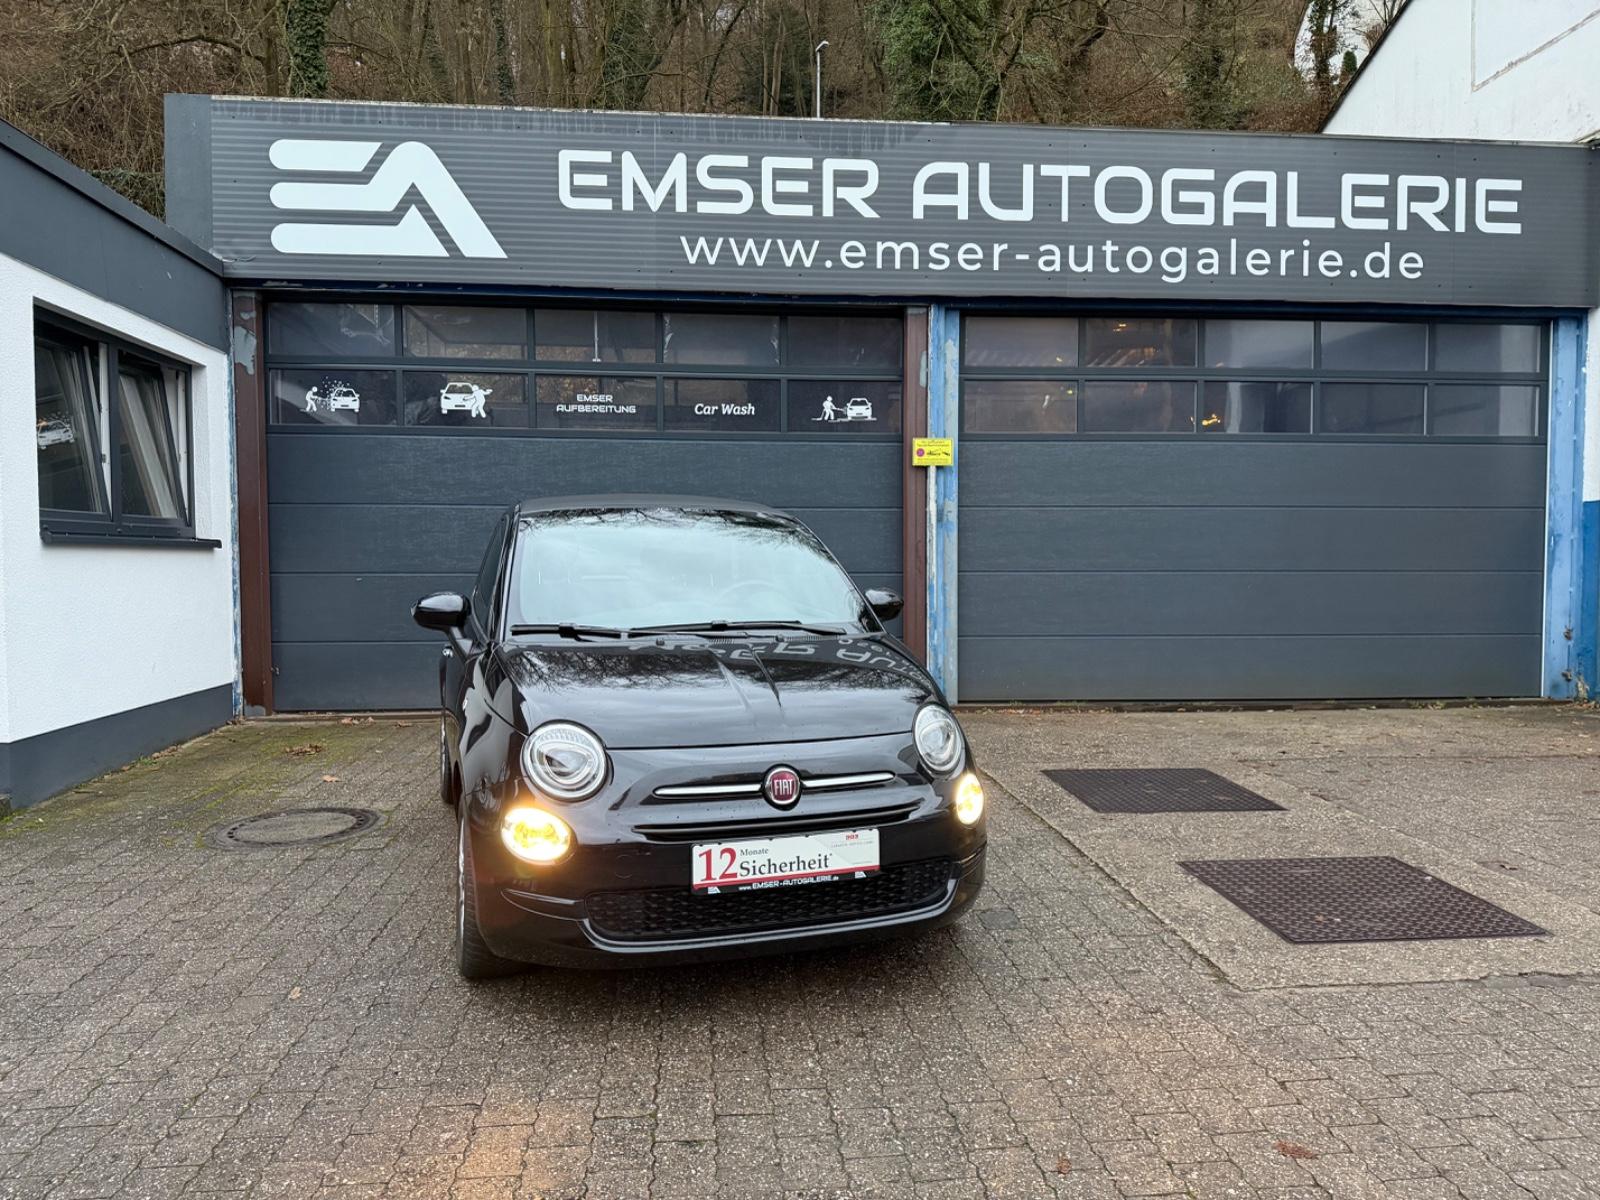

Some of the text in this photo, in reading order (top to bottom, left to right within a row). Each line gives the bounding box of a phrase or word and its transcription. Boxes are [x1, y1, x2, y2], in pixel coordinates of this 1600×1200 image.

[558, 149, 1522, 234] EMSER AUTOGALERIE
[680, 235, 1424, 284] www.emser-autogalerie.de
[576, 394, 613, 403] EMSER
[556, 404, 636, 414] AUFBEREITUNG
[694, 403, 756, 415] Car Wash
[773, 779, 793, 796] FIAT
[698, 848, 769, 882] 12 Monate
